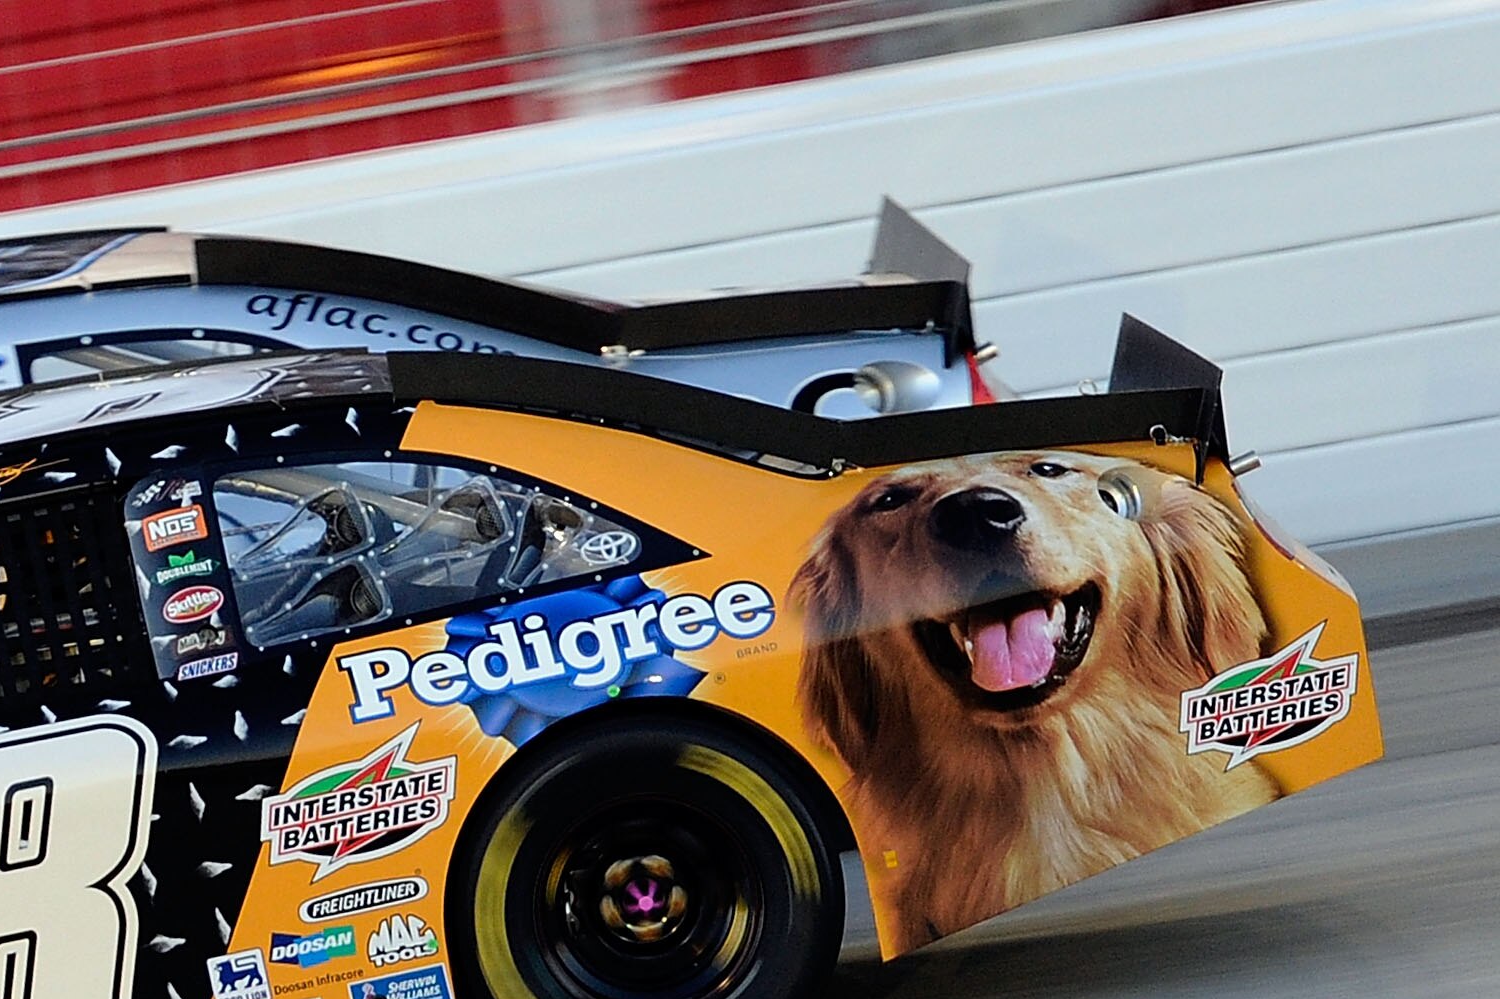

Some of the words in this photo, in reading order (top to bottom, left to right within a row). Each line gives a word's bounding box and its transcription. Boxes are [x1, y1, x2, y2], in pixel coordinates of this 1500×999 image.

[148, 510, 198, 541] NOS
[167, 590, 219, 618] Skittles
[181, 654, 236, 678] SNICKERS
[340, 581, 776, 723] Pedigree
[736, 642, 778, 660] BRAND
[1191, 667, 1347, 719] INTERSTATE
[1200, 693, 1340, 741] BATTERIES
[273, 771, 444, 827] INTERSTATE
[283, 797, 436, 850] BATTERIES
[311, 881, 416, 918] FREIGHTLINER
[270, 931, 353, 961] DOOSAN
[368, 913, 437, 956] MAC
[370, 942, 437, 967] TOOLS
[273, 978, 314, 997] Doosan
[316, 967, 365, 987] Infracore
[388, 974, 437, 994] SHERWIN
